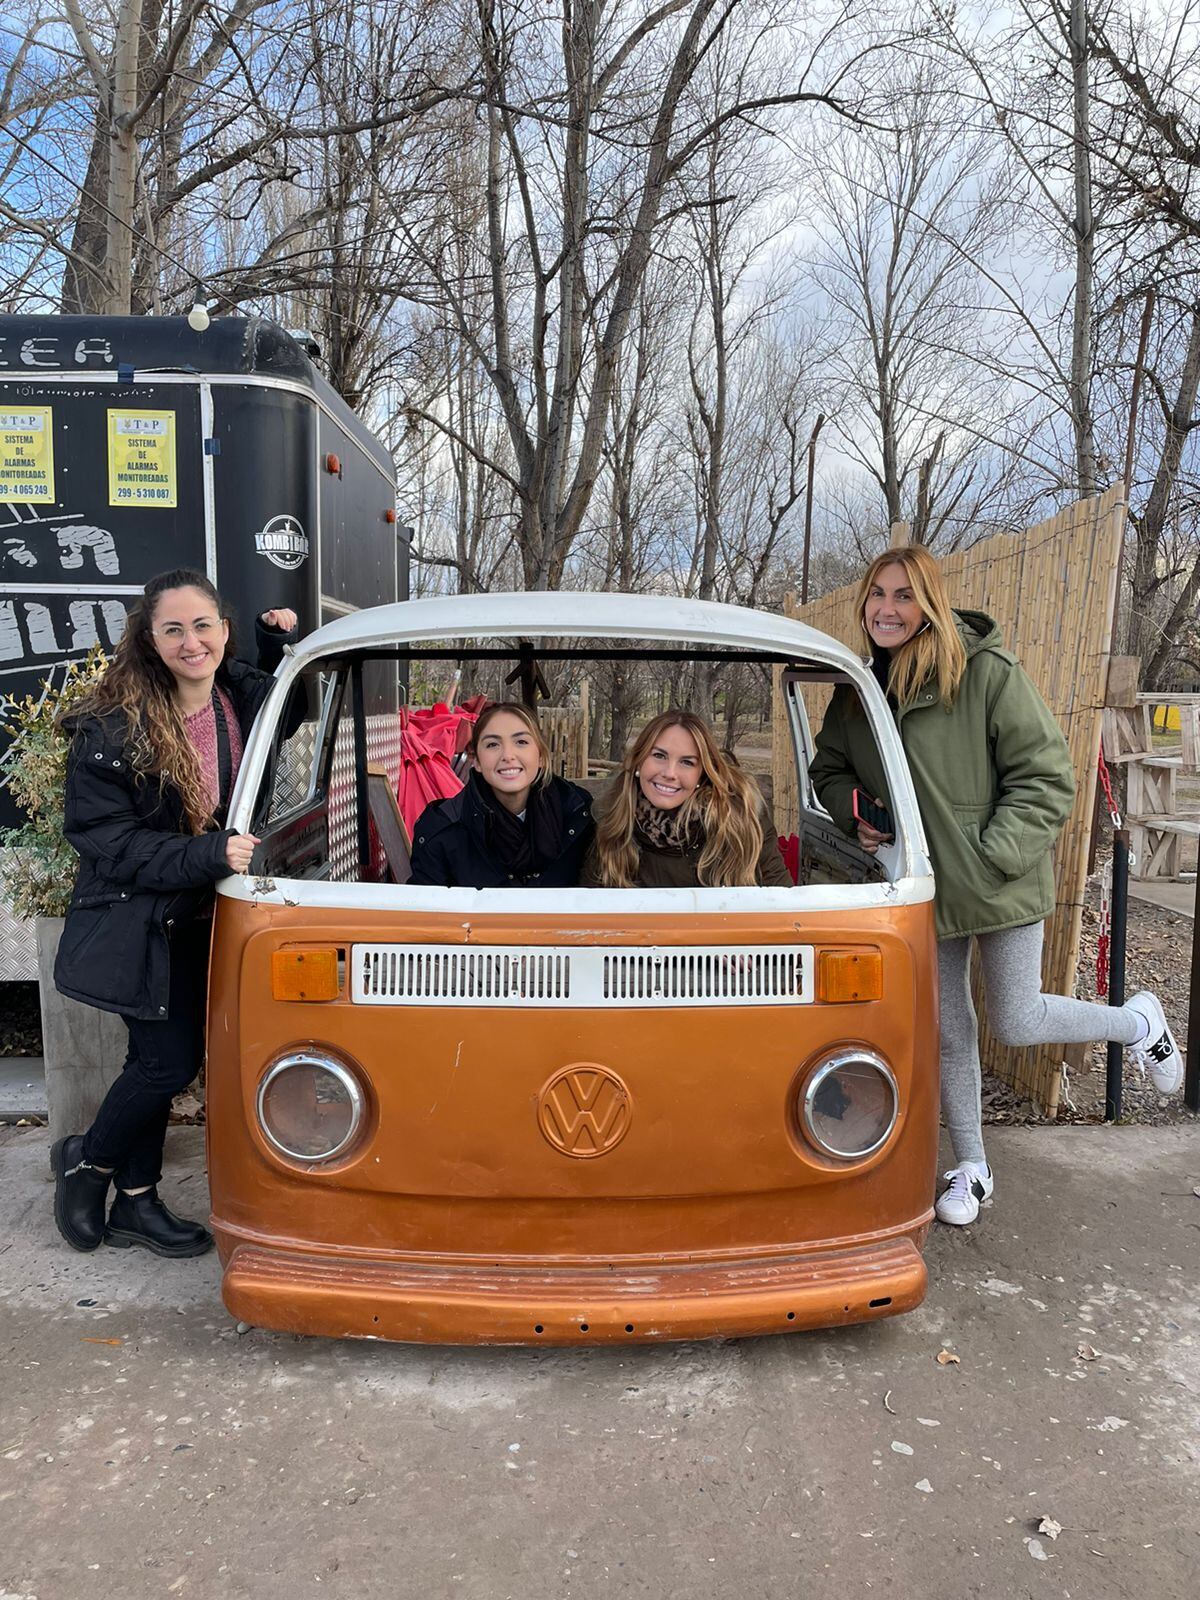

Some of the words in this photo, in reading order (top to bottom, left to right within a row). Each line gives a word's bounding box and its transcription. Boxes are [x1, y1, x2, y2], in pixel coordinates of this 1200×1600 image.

[4, 435, 34, 444] SISTEMA
[127, 439, 157, 447] SISTEMA
[15, 446, 24, 455] DE
[138, 451, 147, 459] DE
[4, 458, 36, 467] ALARMAS
[127, 461, 159, 471] ALARMAS
[0, 470, 46, 479] ONITOREADAS
[117, 473, 169, 483] MONITOREADAS
[118, 488, 131, 498] 299
